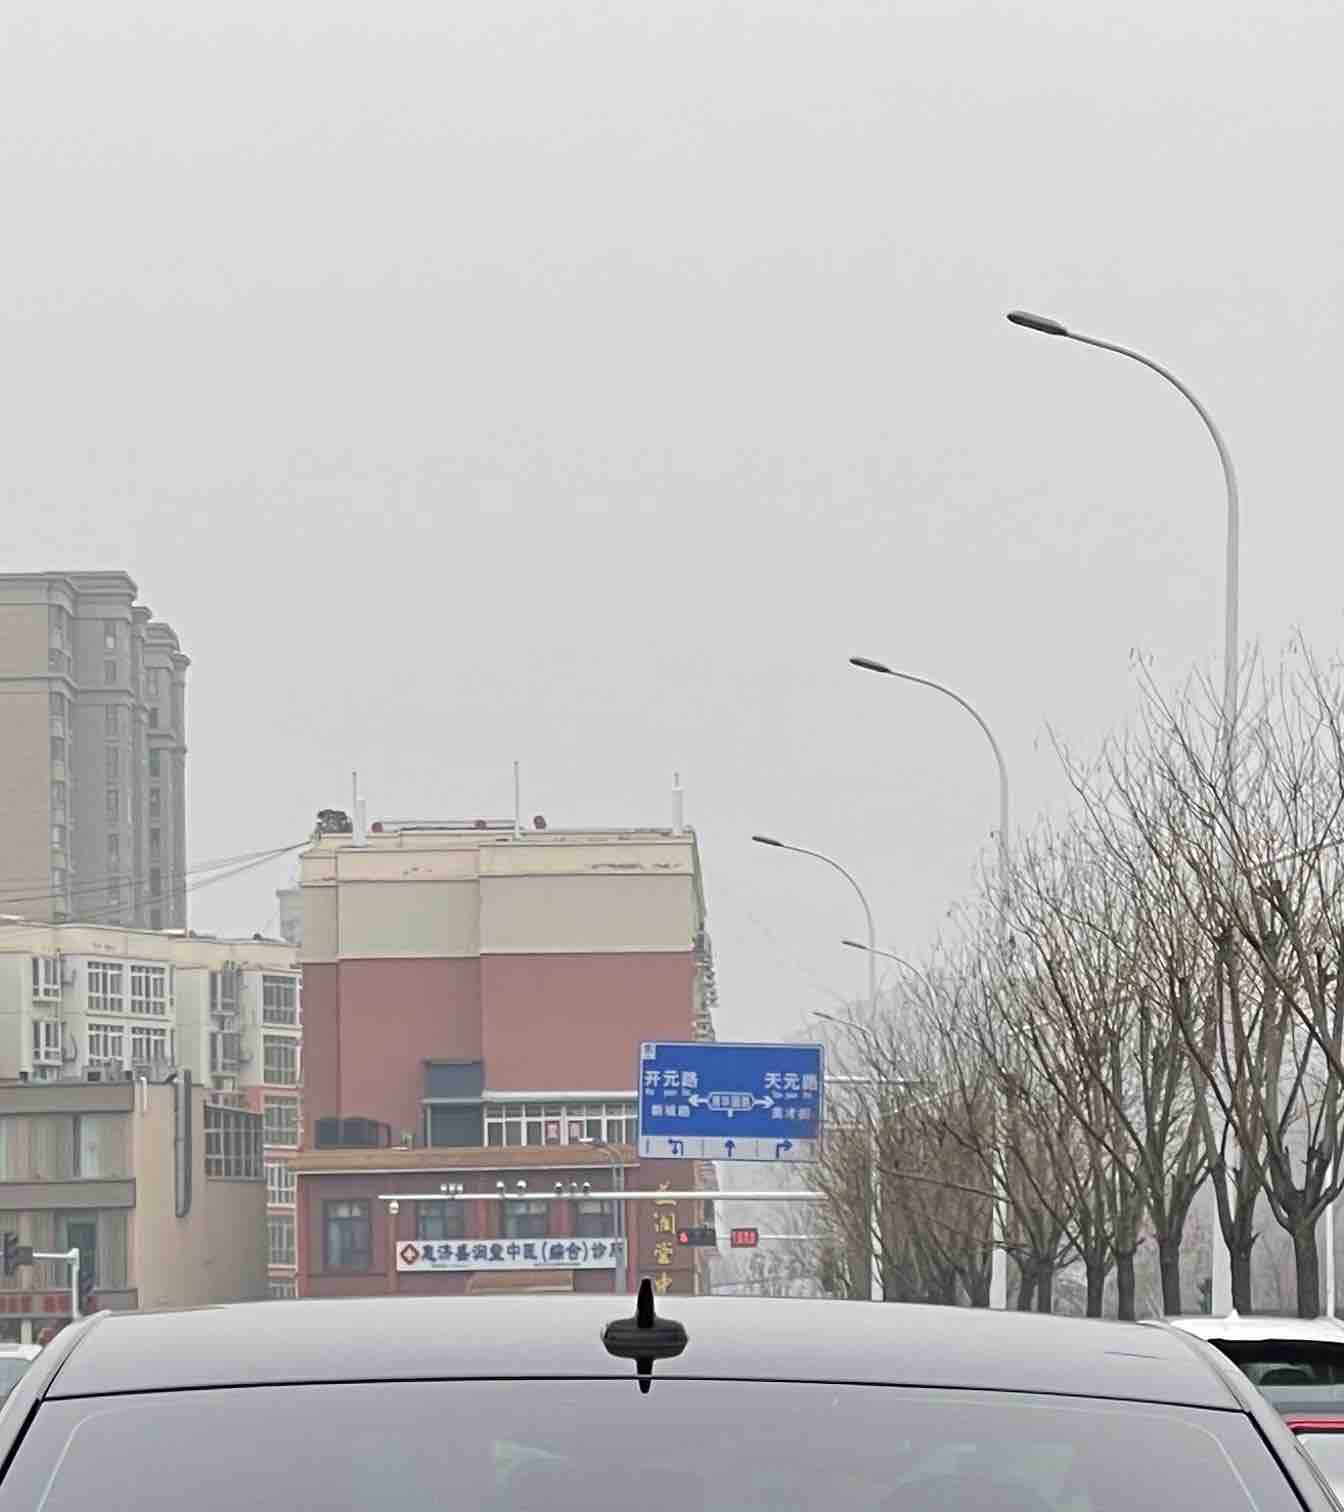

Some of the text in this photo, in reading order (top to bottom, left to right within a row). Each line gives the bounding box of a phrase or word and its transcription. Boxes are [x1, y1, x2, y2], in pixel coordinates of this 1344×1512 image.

[644, 1070, 698, 1088] 开元路
[764, 1072, 818, 1091] 天元路
